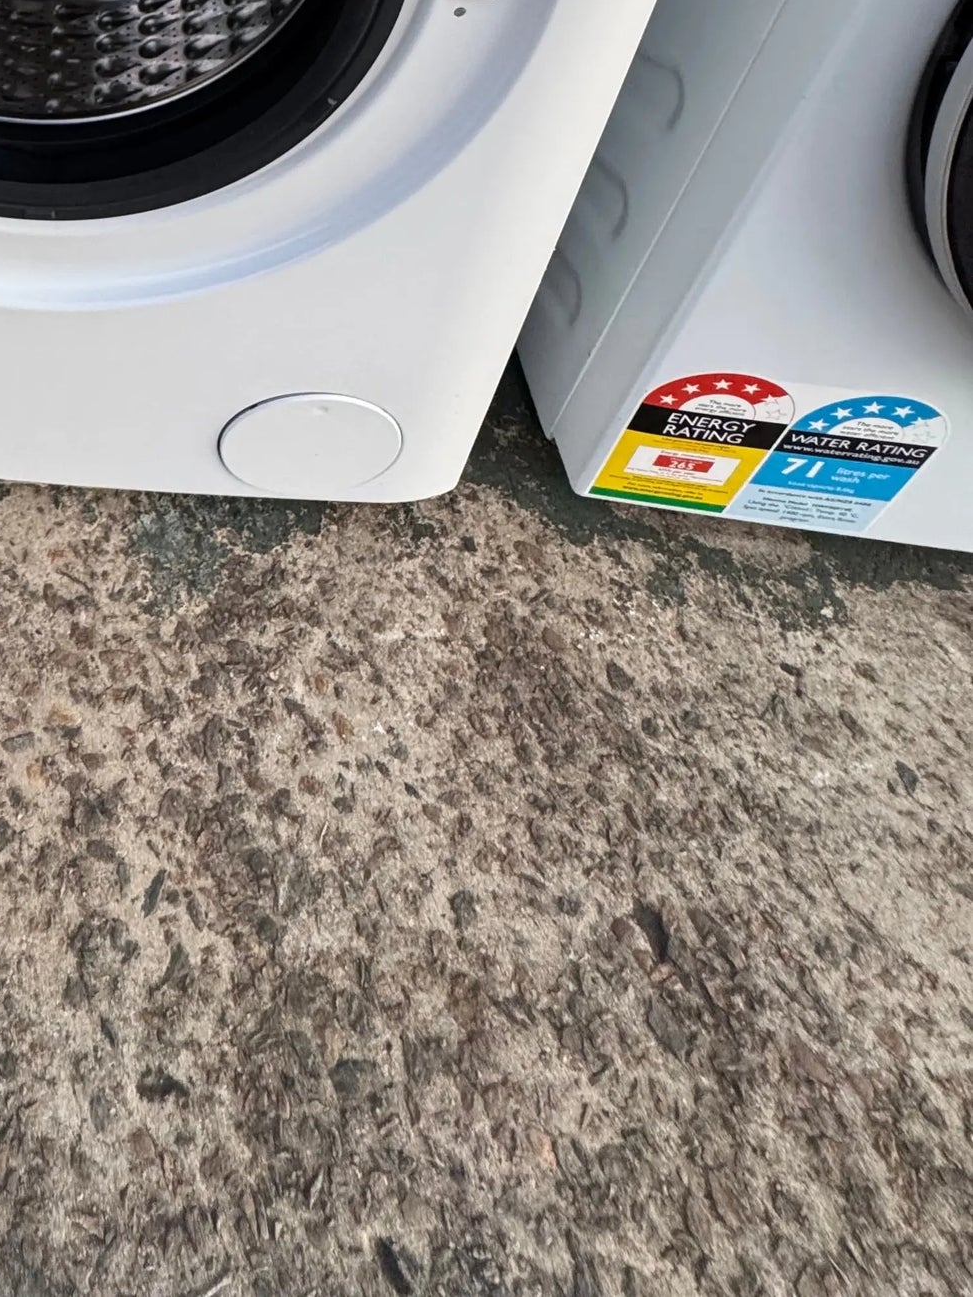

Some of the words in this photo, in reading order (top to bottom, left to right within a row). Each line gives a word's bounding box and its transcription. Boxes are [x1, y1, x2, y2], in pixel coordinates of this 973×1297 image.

[662, 424, 745, 444] RATING
[667, 412, 756, 434] ENERGY
[782, 444, 921, 466] www.waterrating.gov.au
[790, 433, 851, 450] WATER
[855, 442, 928, 459] RATING
[668, 461, 696, 471] 265
[781, 457, 826, 479] 71
[867, 472, 891, 480] per
